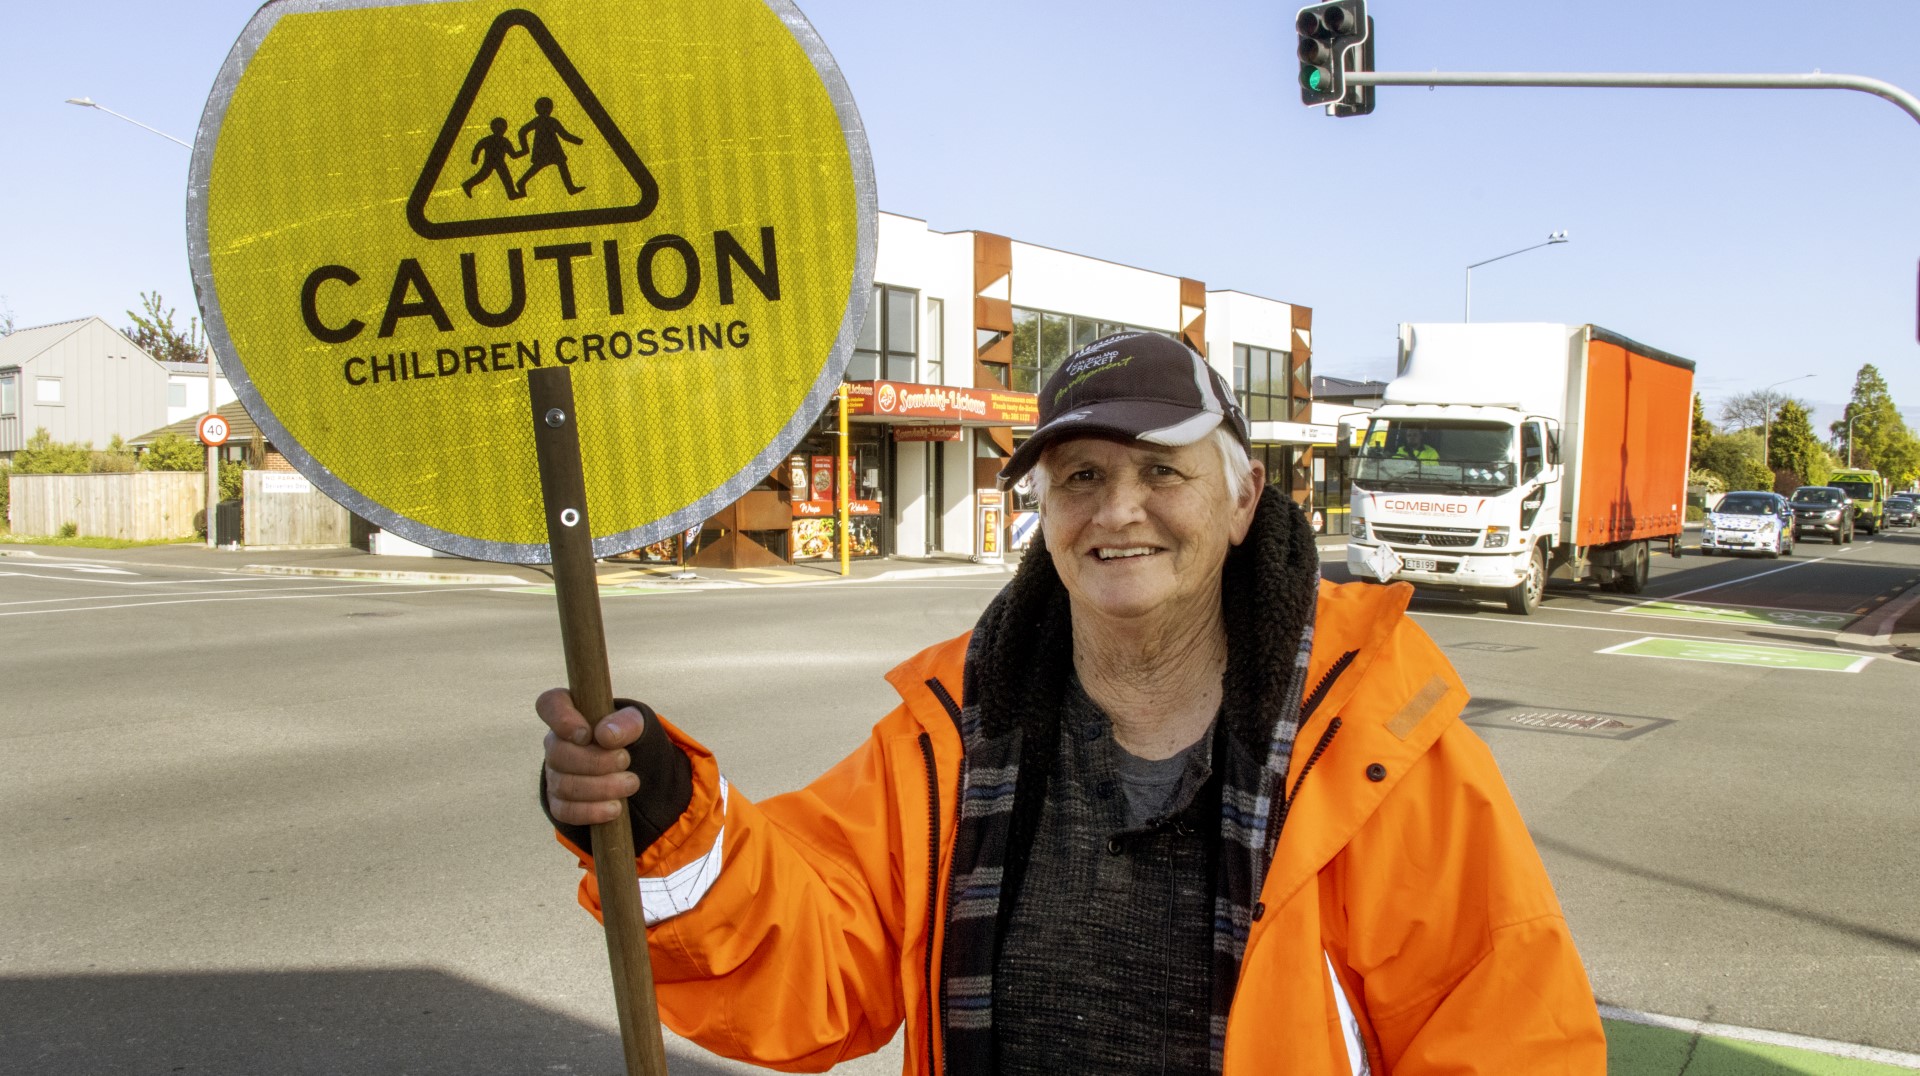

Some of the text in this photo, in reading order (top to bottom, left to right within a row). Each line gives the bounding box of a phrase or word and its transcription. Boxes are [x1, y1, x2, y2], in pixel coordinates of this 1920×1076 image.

[301, 226, 781, 344] CAUTION
[344, 320, 751, 386] CHILDREN CROSSING
[1087, 351, 1119, 363] ZEALAND
[1070, 356, 1117, 376] CRICKET
[899, 388, 986, 415] Souvlaki-Licious
[207, 424, 223, 436] 40
[800, 502, 821, 515] Wraps
[1384, 500, 1468, 514] COMBINED
[984, 512, 996, 552] OPEN
